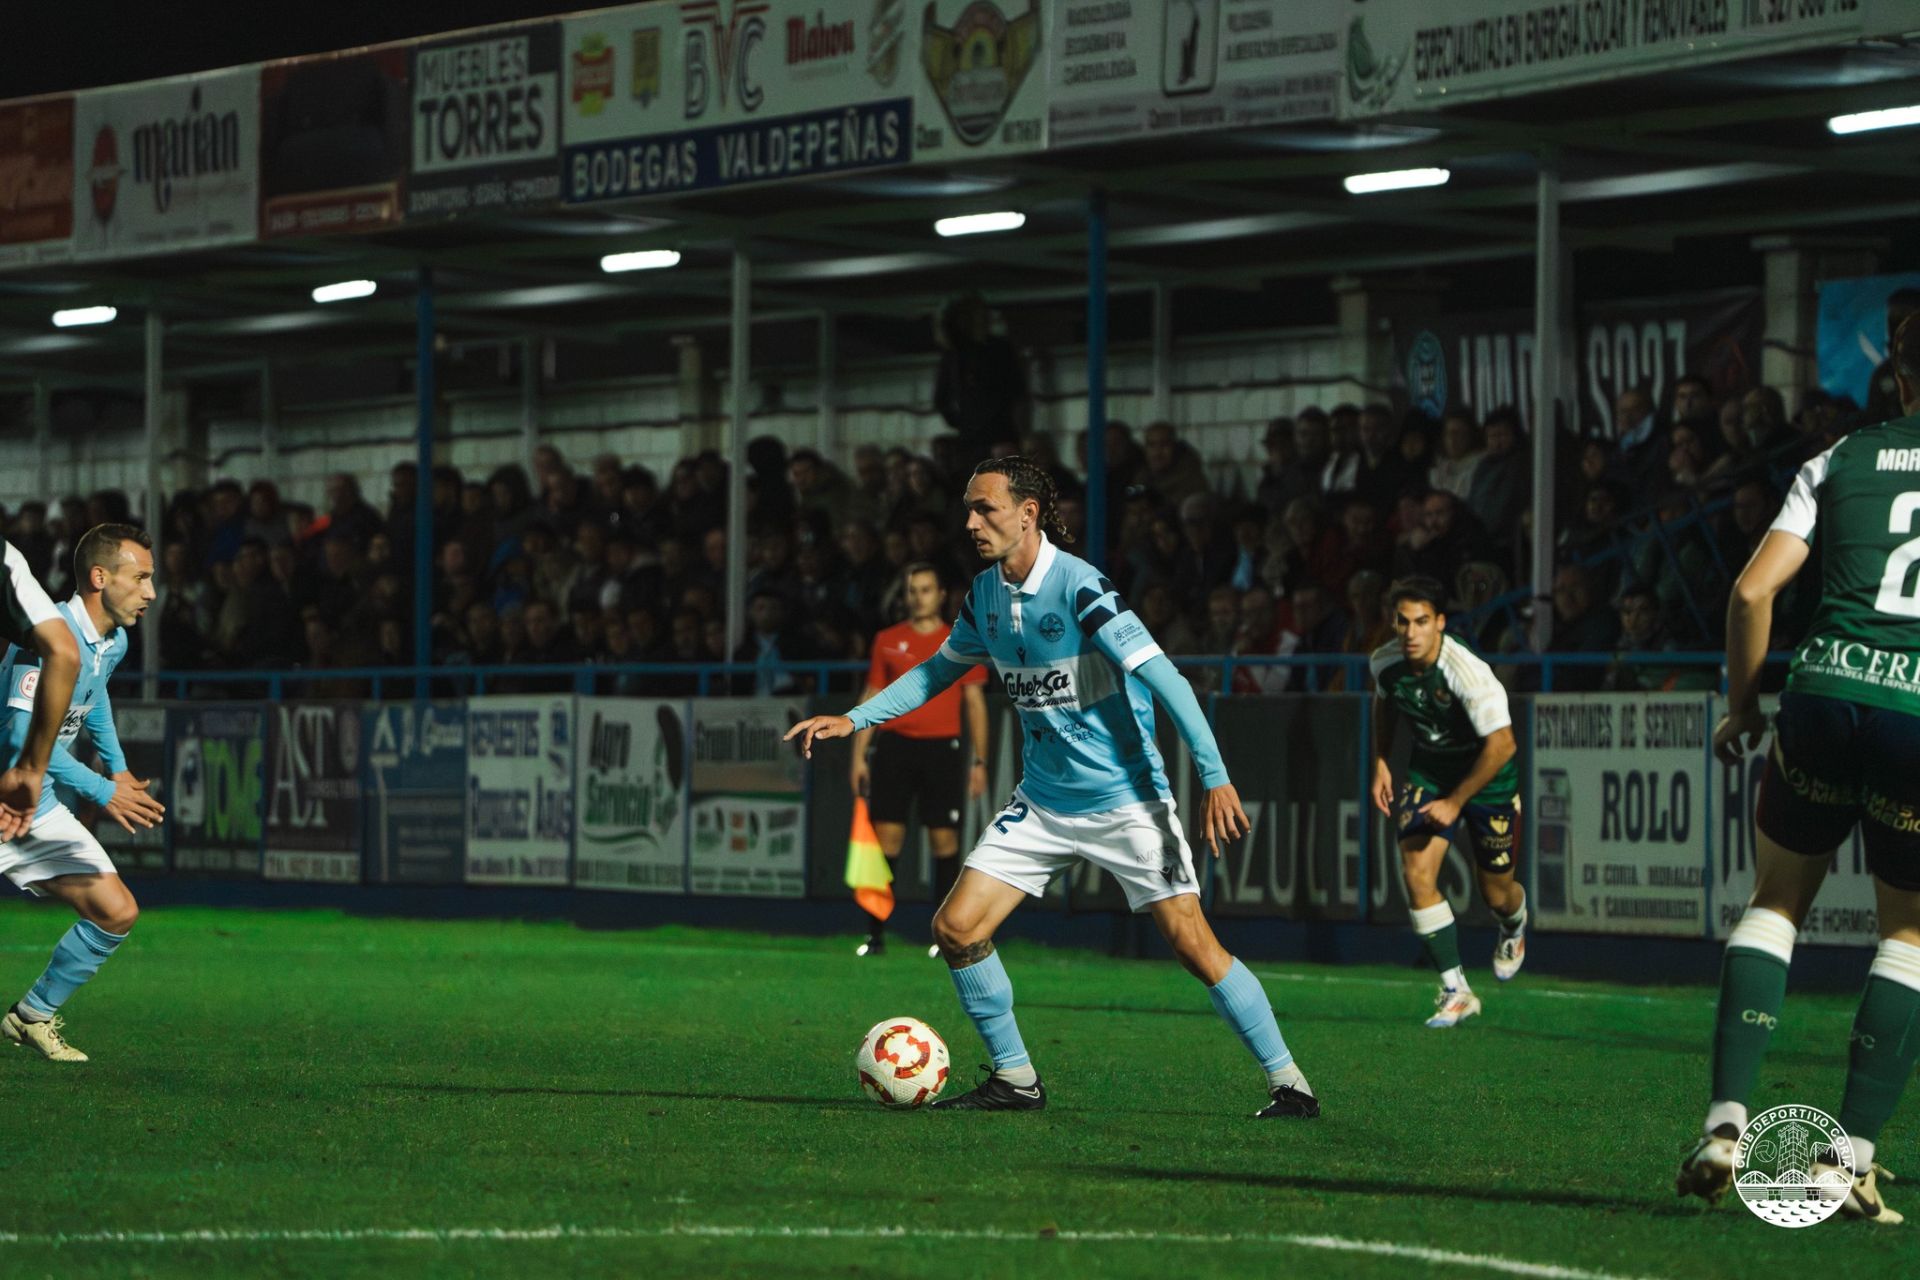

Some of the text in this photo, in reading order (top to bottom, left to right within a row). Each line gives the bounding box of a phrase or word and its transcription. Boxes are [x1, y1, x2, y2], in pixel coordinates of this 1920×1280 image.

[419, 40, 526, 91] MUEBLES
[419, 82, 543, 162] TORRES
[571, 139, 699, 199] BODEGAS
[717, 107, 900, 181] VALDEPEÑAS
[1601, 769, 1691, 844] ROLO
[1203, 799, 1473, 914] AZULEJS
[1741, 1009, 1778, 1031] CPC
